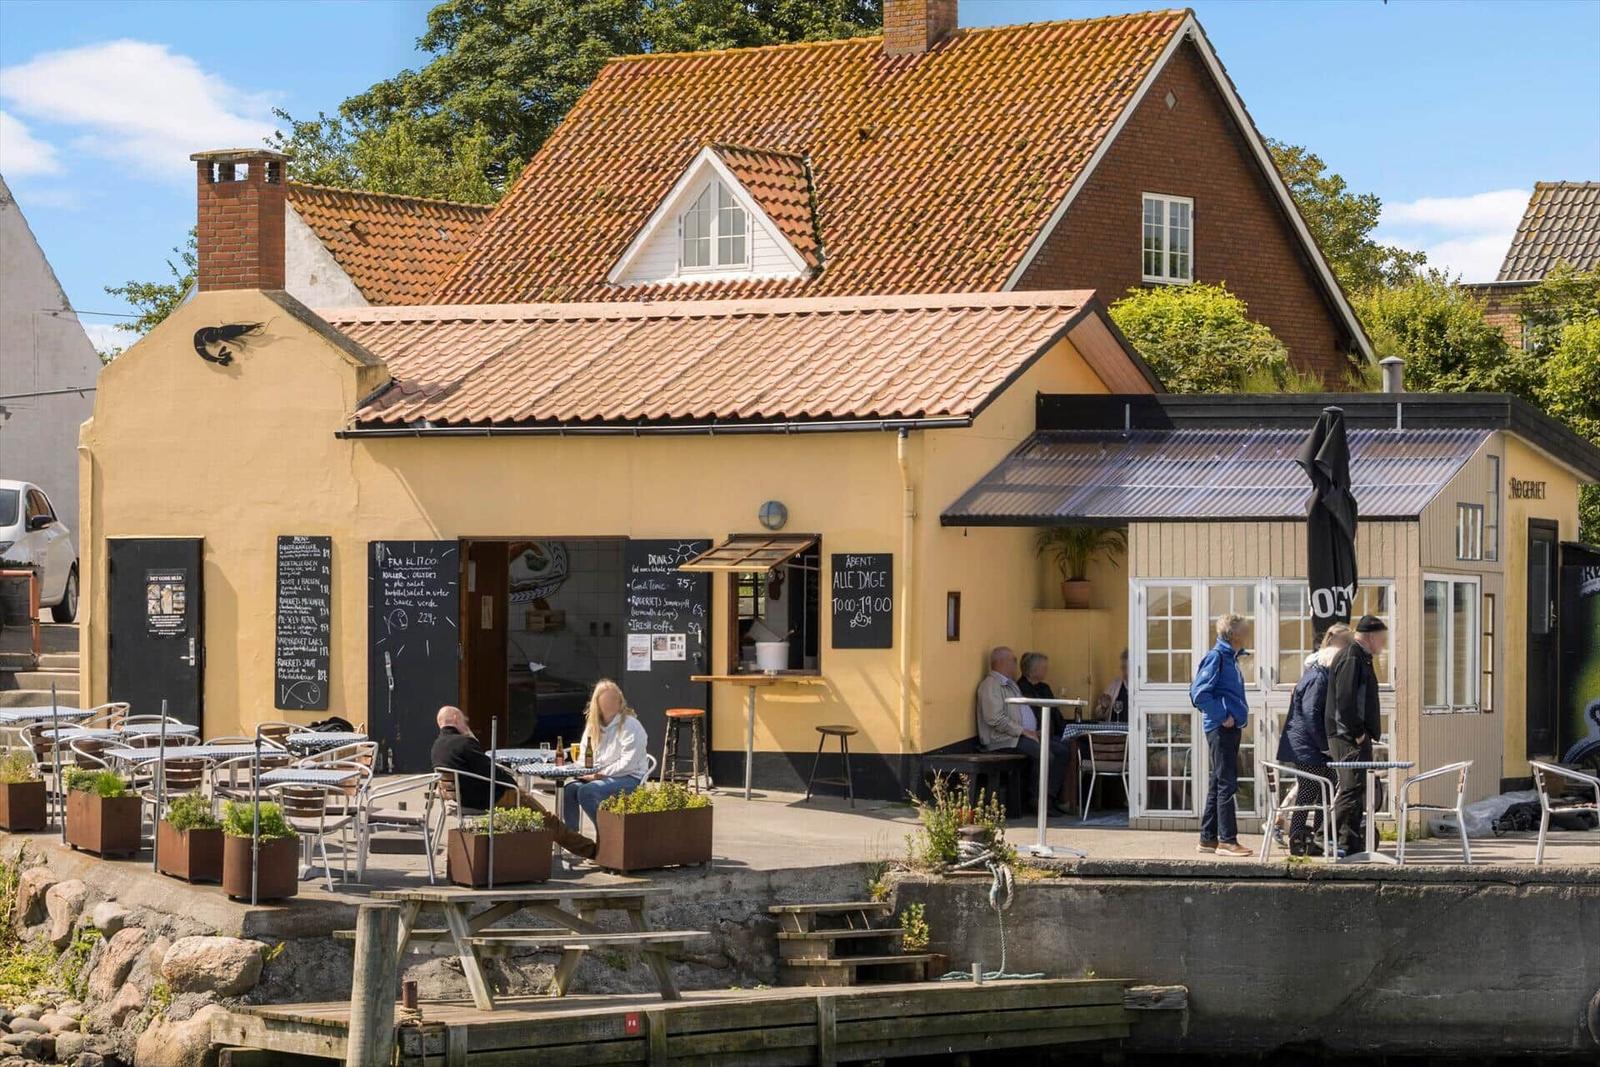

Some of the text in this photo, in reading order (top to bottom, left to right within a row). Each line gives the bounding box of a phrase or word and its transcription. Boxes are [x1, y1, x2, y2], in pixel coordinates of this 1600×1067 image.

[648, 554, 674, 565] DRINKS
[833, 571, 887, 590] ALLE DAGE
